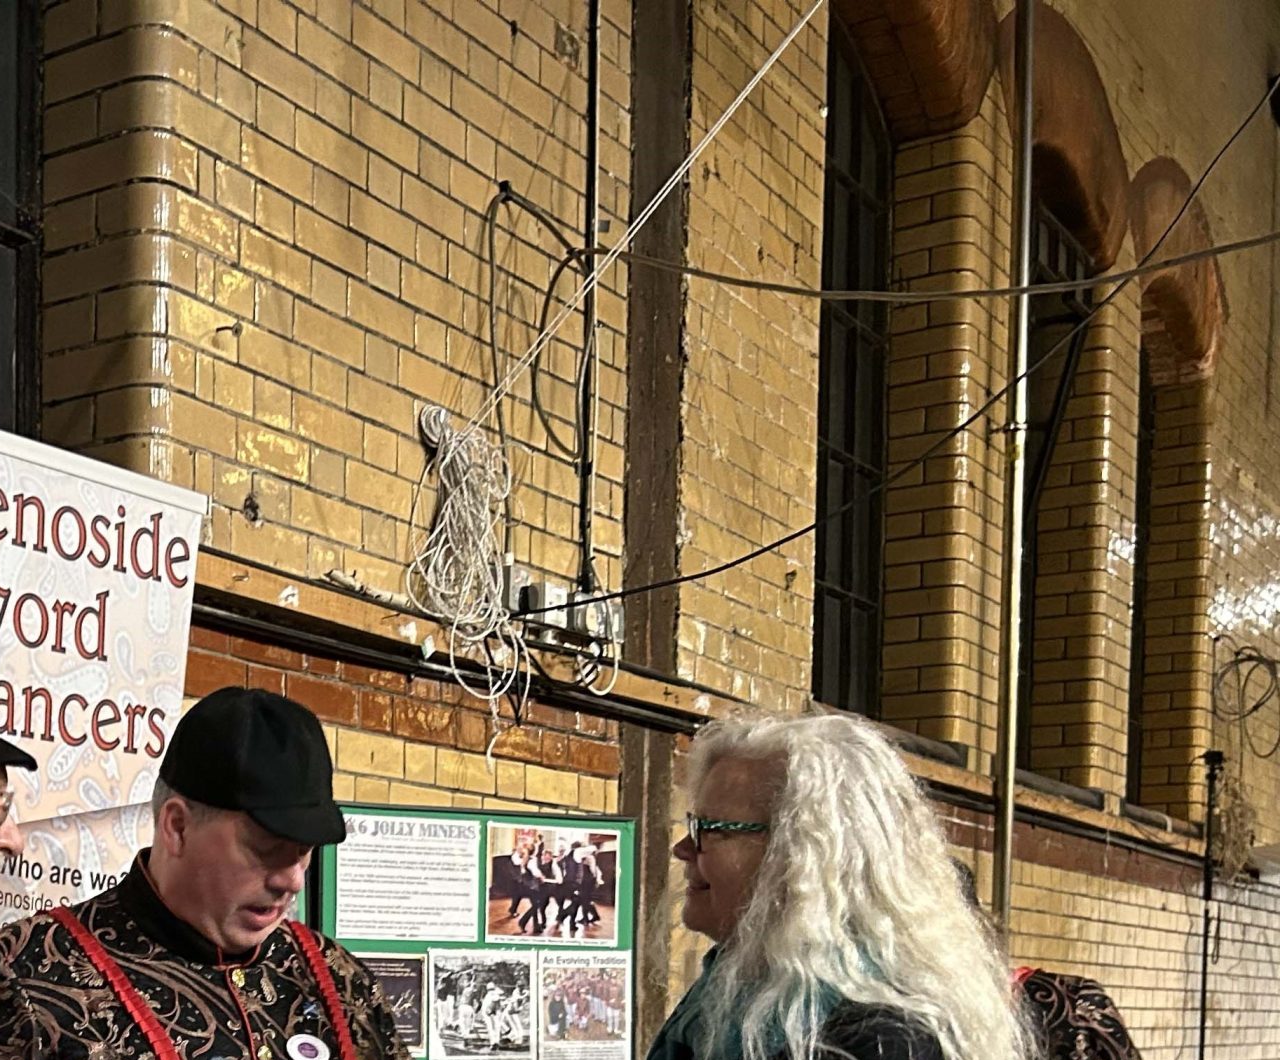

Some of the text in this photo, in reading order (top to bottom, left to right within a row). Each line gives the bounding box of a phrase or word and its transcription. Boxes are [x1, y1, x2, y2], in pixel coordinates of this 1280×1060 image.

[358, 820, 477, 840] 6 JOLLY MINERS
[49, 865, 83, 888] are
[542, 956, 627, 967] An Evolving Tradition
